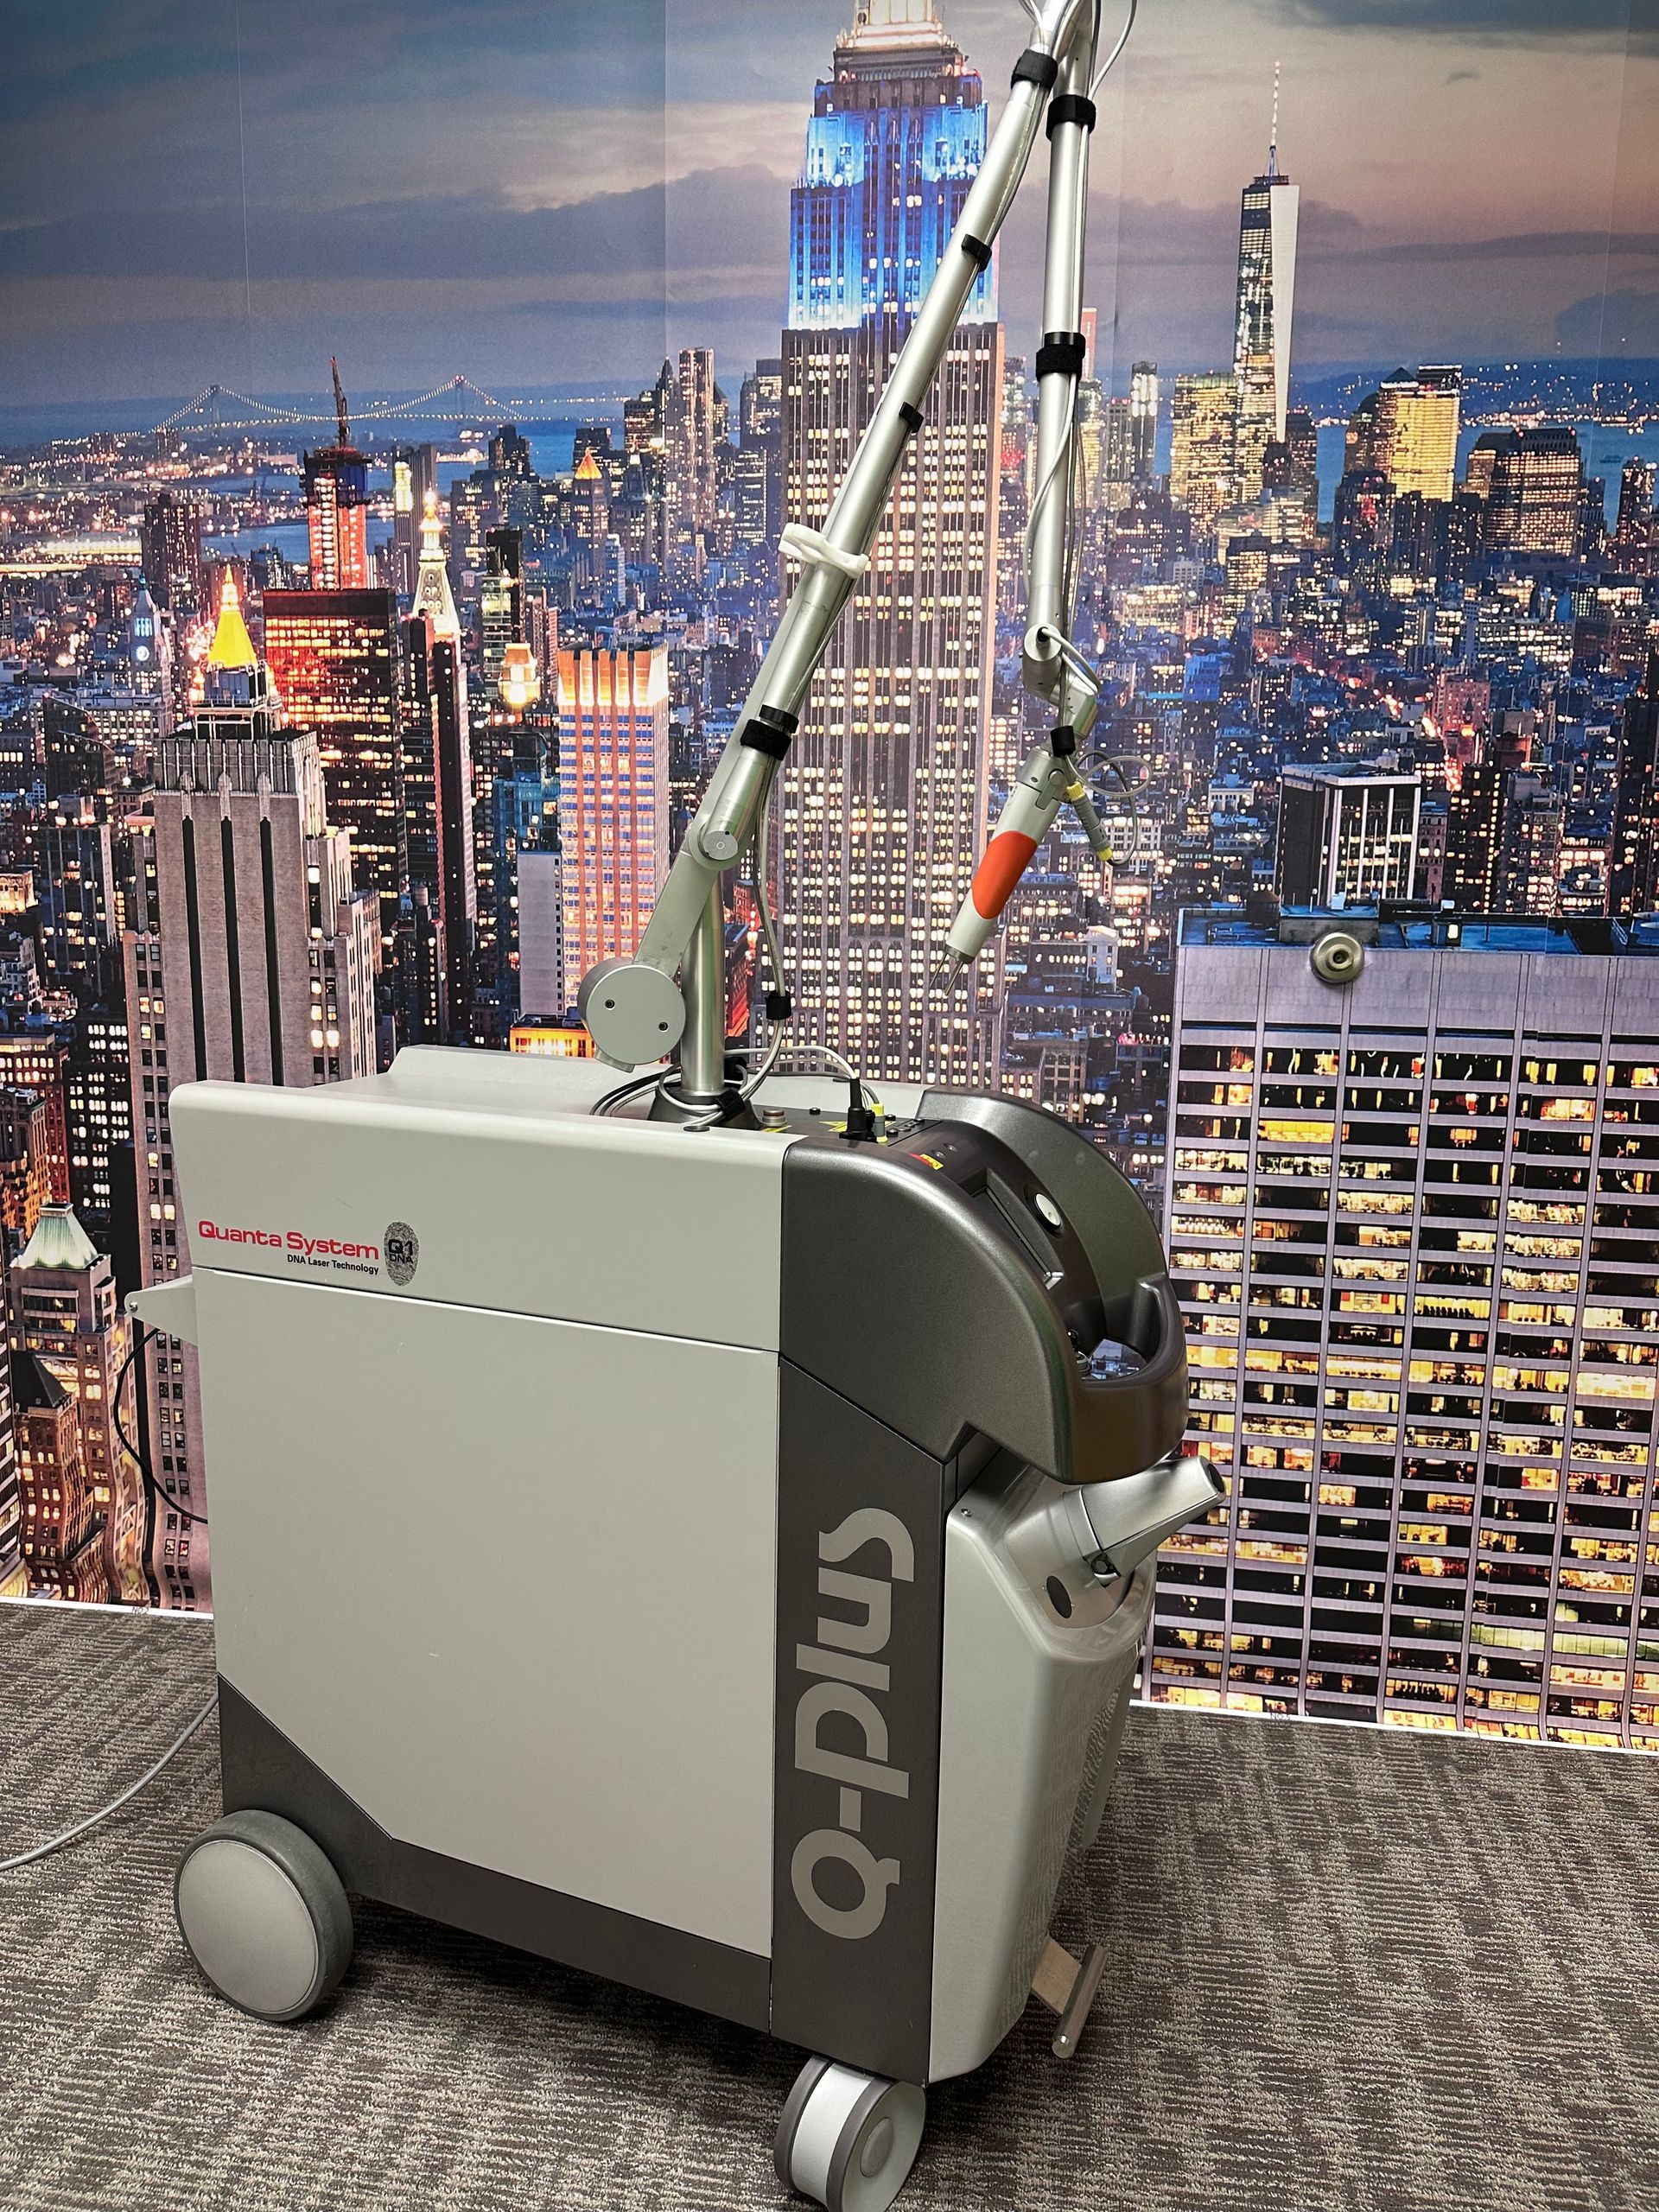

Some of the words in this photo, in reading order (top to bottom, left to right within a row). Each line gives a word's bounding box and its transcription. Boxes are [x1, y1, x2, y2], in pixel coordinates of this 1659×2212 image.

[198, 1220, 282, 1247] Quanta
[286, 1231, 378, 1259] System
[388, 1238, 413, 1256] Q1
[287, 1254, 306, 1264] DNA
[308, 1256, 329, 1267] Laser
[331, 1260, 378, 1275] Technology
[389, 1254, 414, 1264] DNA
[791, 1508, 914, 1939] Q-plus
